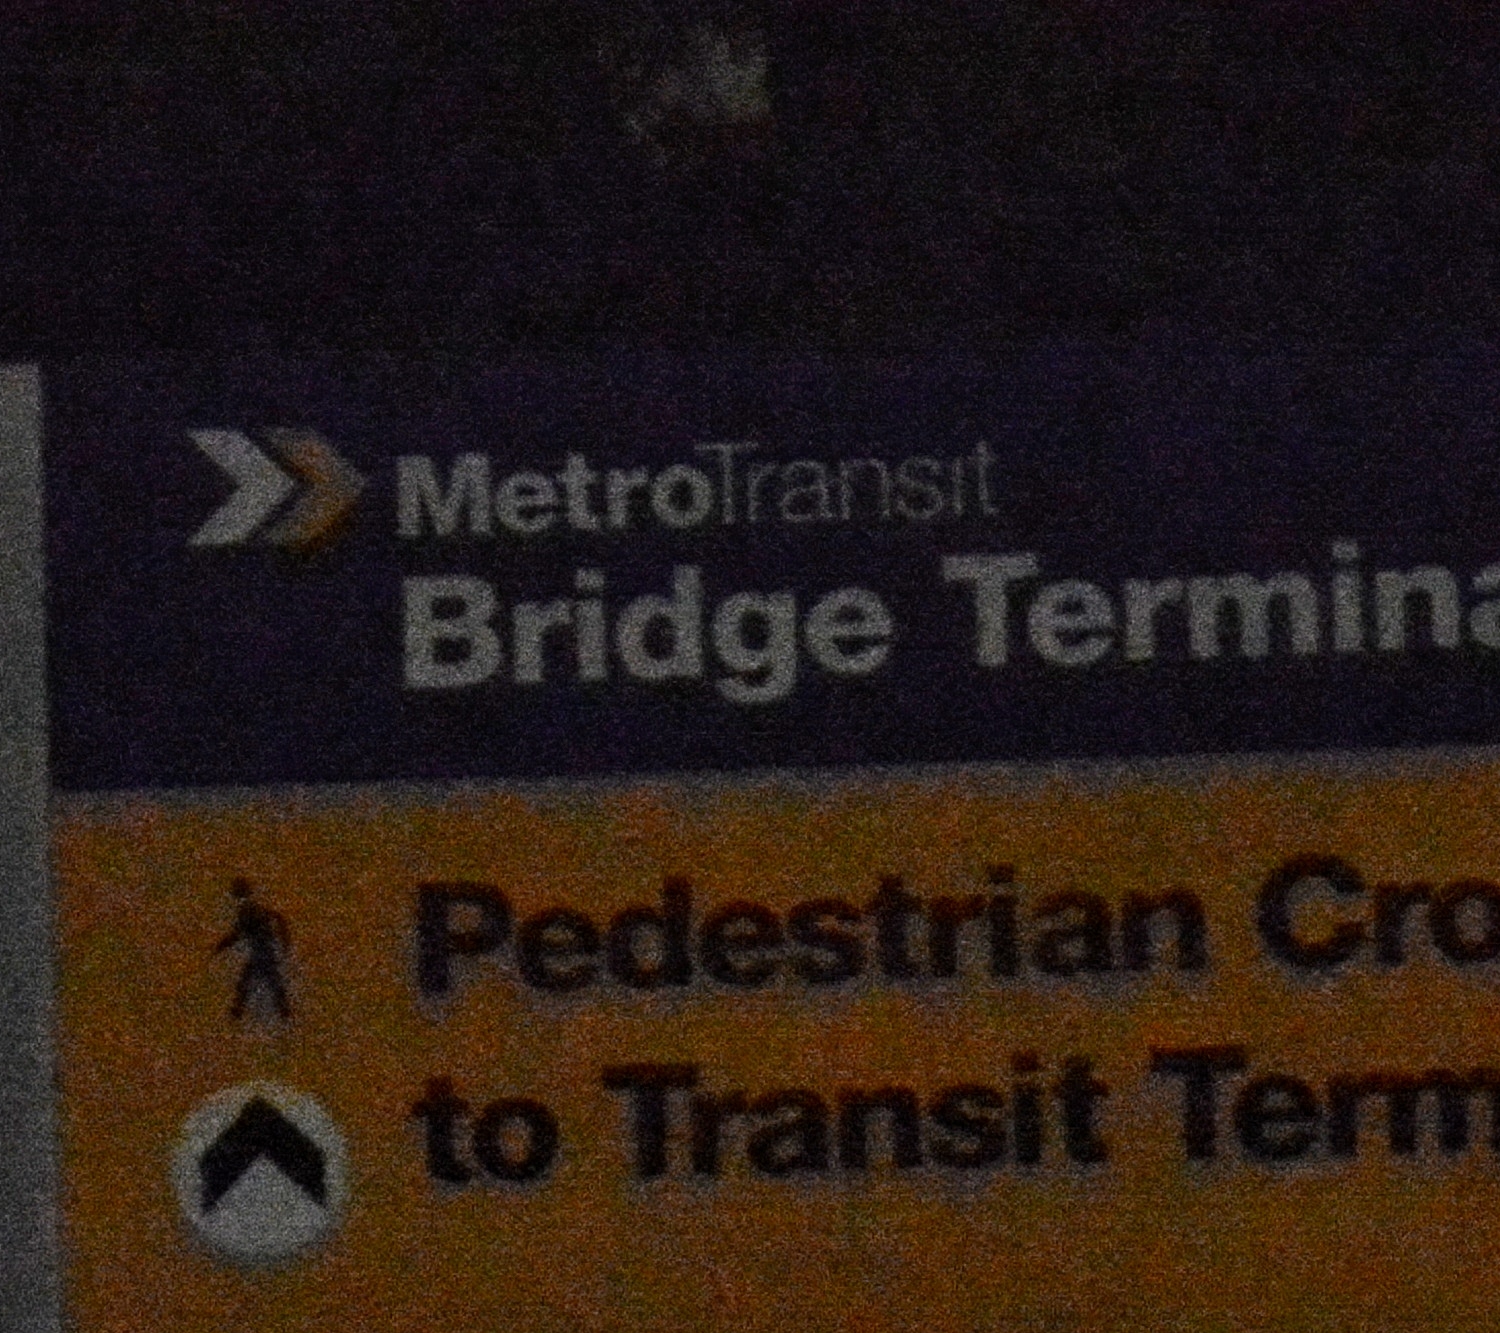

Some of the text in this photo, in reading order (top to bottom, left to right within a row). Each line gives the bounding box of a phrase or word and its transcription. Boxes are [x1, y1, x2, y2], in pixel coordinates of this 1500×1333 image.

[395, 440, 1001, 537] MetroTransit
[402, 564, 894, 703] Bridge
[416, 865, 1209, 994] Pedestrian
[414, 1075, 560, 1184] to
[602, 1050, 1109, 1180] Transit
